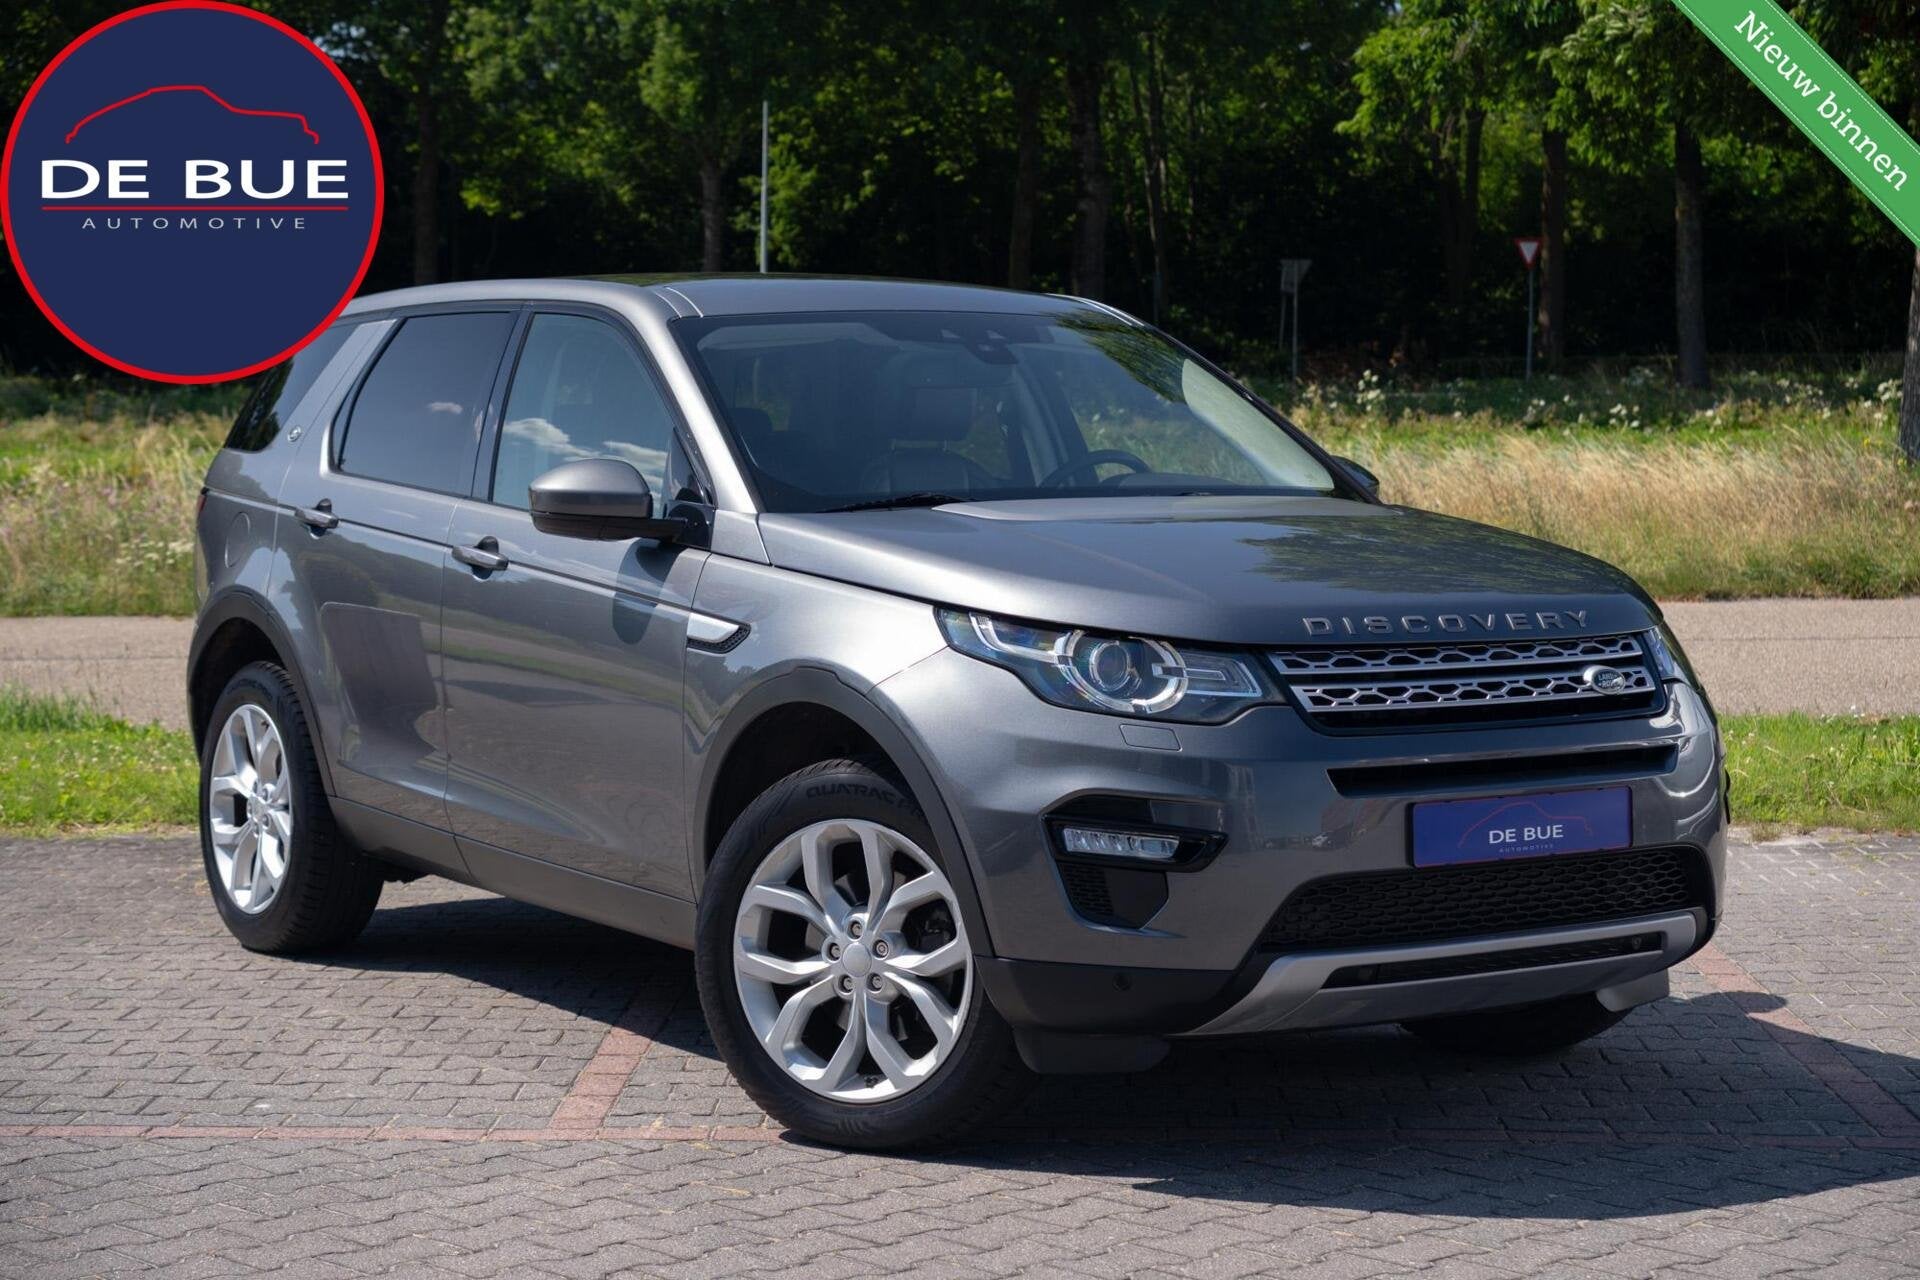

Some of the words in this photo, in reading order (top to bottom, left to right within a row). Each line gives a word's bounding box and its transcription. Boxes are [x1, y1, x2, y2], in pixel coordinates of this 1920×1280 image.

[1302, 610, 1587, 636] DISCOVERY
[806, 783, 897, 805] QUATRAC
[1488, 828, 1517, 844] DE
[1523, 824, 1564, 841] BUE
